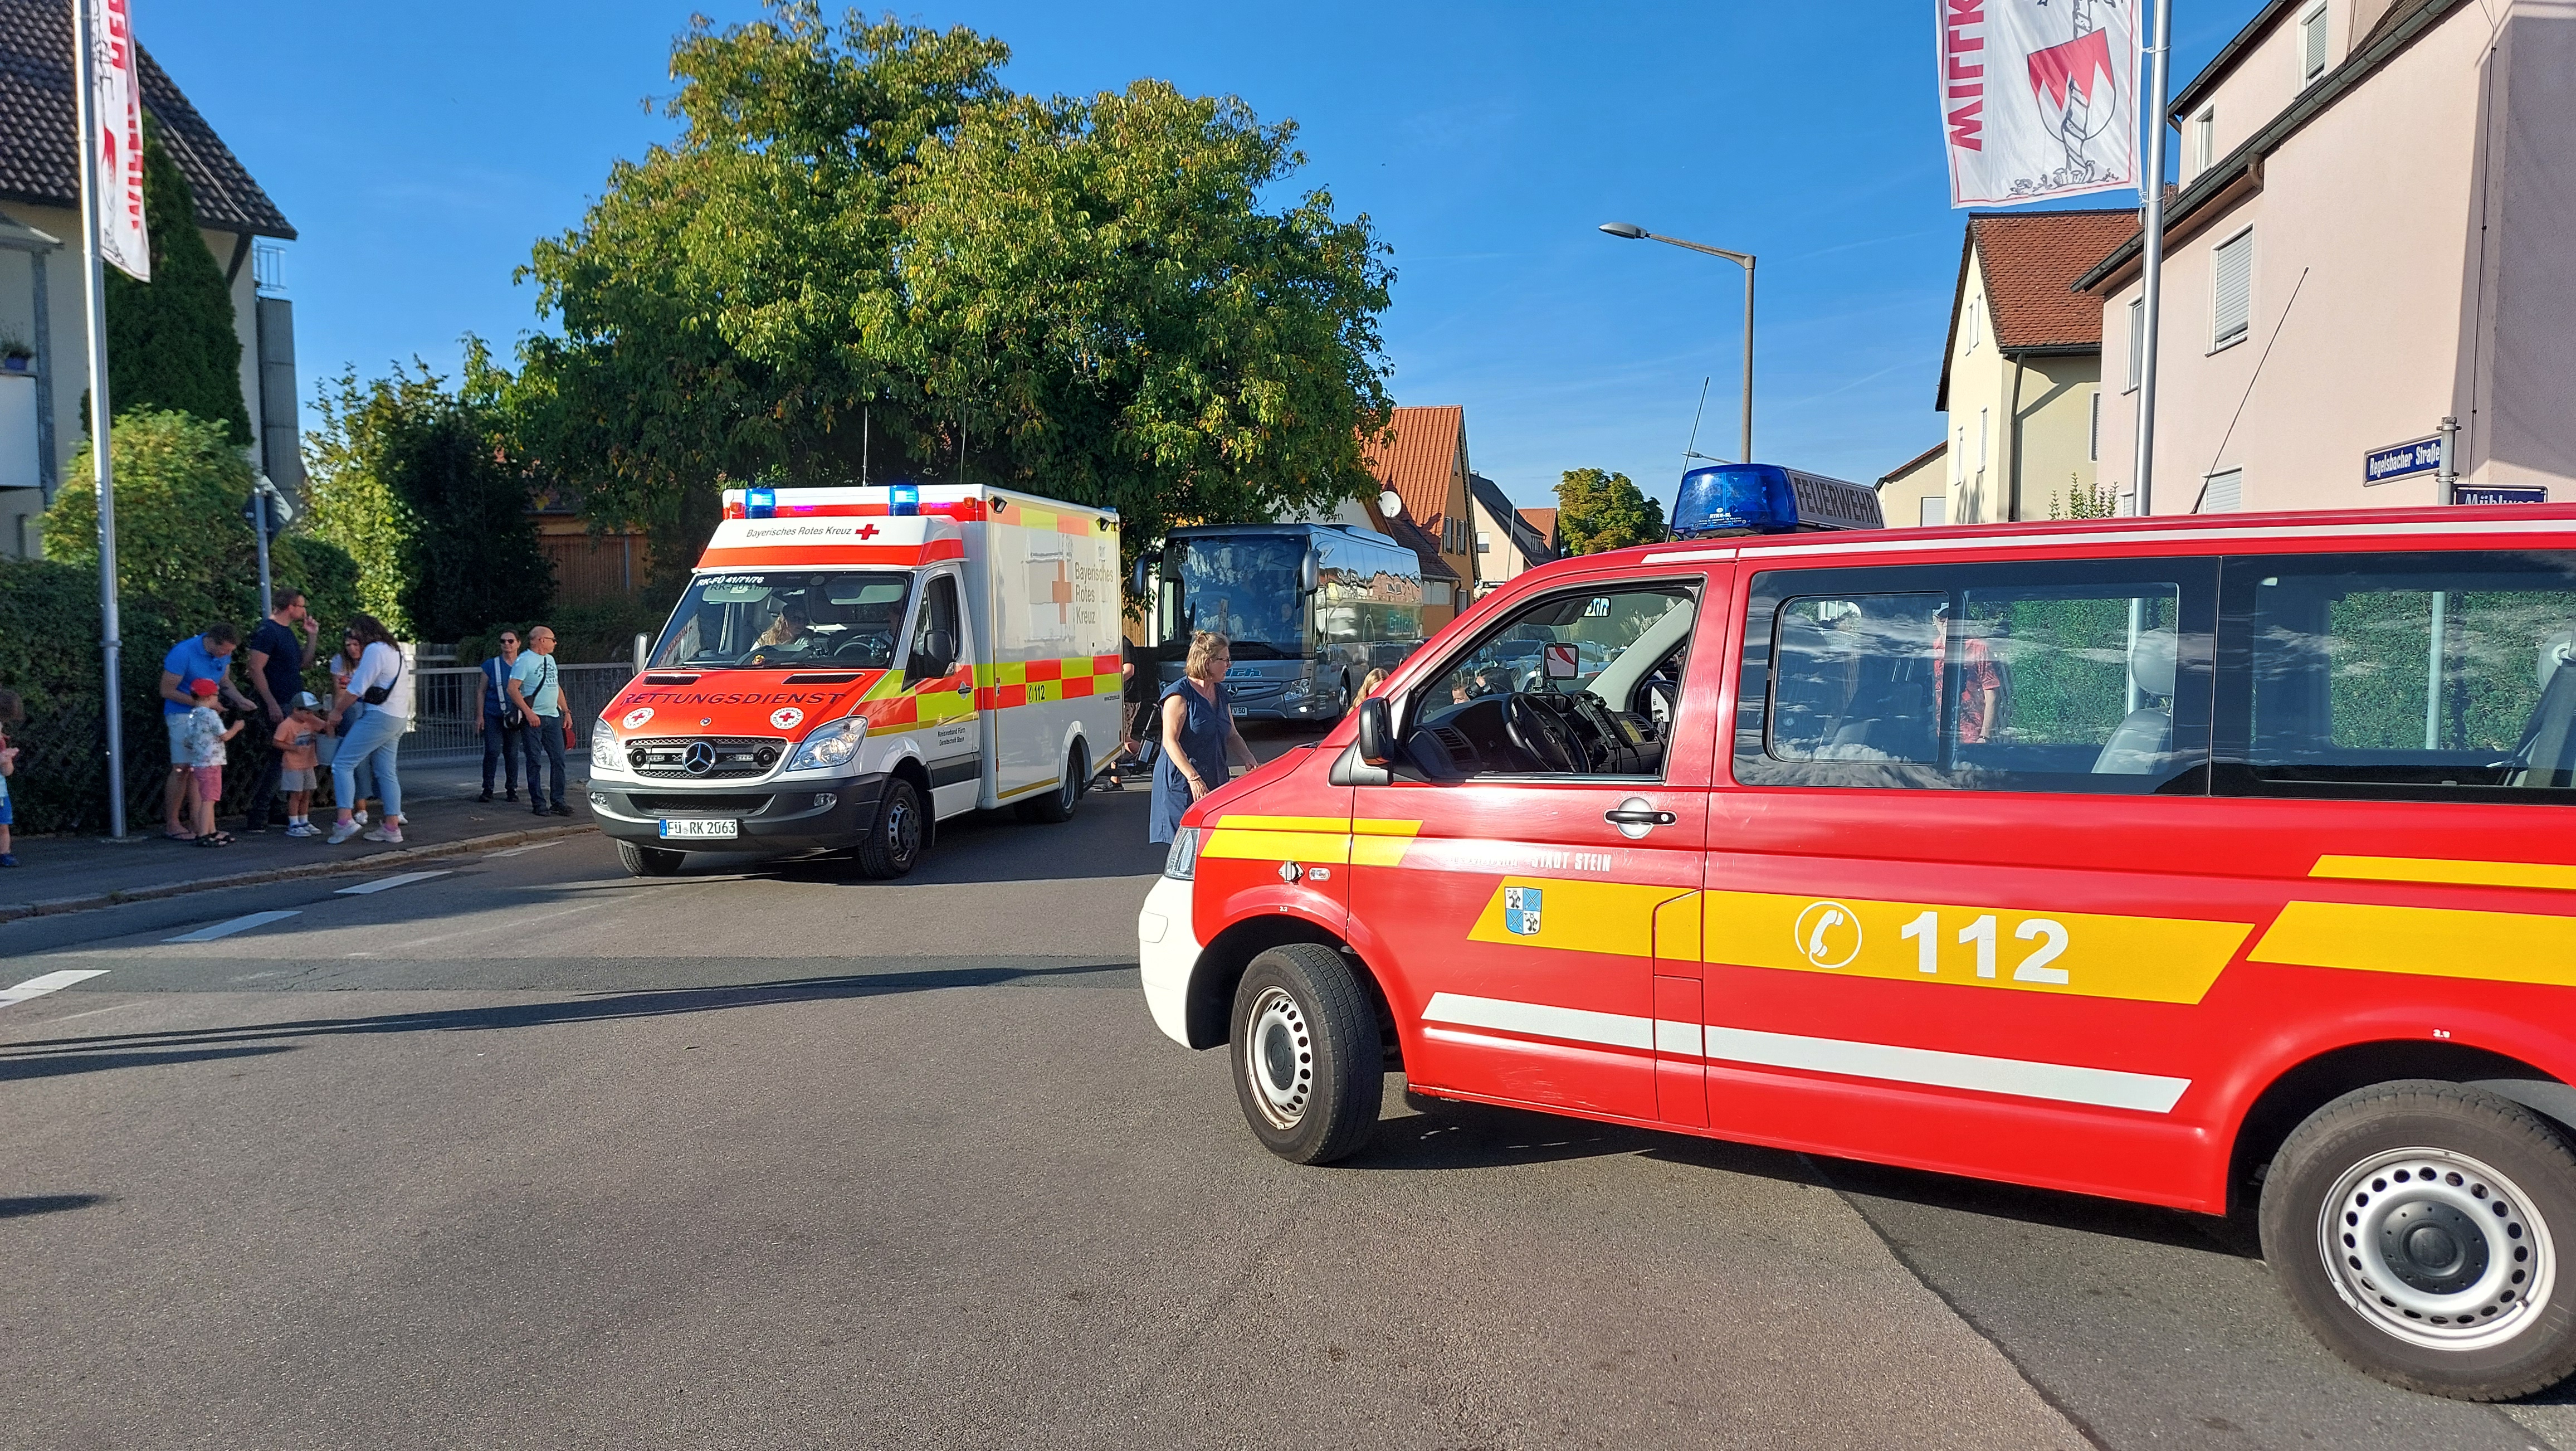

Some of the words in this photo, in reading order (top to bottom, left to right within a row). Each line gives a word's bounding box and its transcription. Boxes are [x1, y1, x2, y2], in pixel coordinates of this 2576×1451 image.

[2369, 450, 2413, 478] Regelsbacher
[2415, 442, 2440, 465] Straße
[1793, 477, 1879, 524] FEUERWEHR
[747, 527, 796, 538] Bayerisches
[798, 527, 823, 535] Rotes
[826, 526, 852, 535] Kreuz
[696, 575, 725, 587] RK-FÜ
[1075, 562, 1114, 585] Bayerisches
[1076, 584, 1095, 603] Rotes
[1076, 606, 1096, 624] Kreuz
[1225, 668, 1262, 678] lch
[620, 692, 847, 706] RETTUNGSDIENST
[1035, 684, 1045, 701] 112
[667, 821, 682, 834] FÜ
[690, 821, 704, 834] RK
[706, 821, 736, 834] 2063
[1531, 850, 1570, 869] STADT
[1574, 853, 1612, 872] STEIN
[1901, 910, 2069, 985] 112
